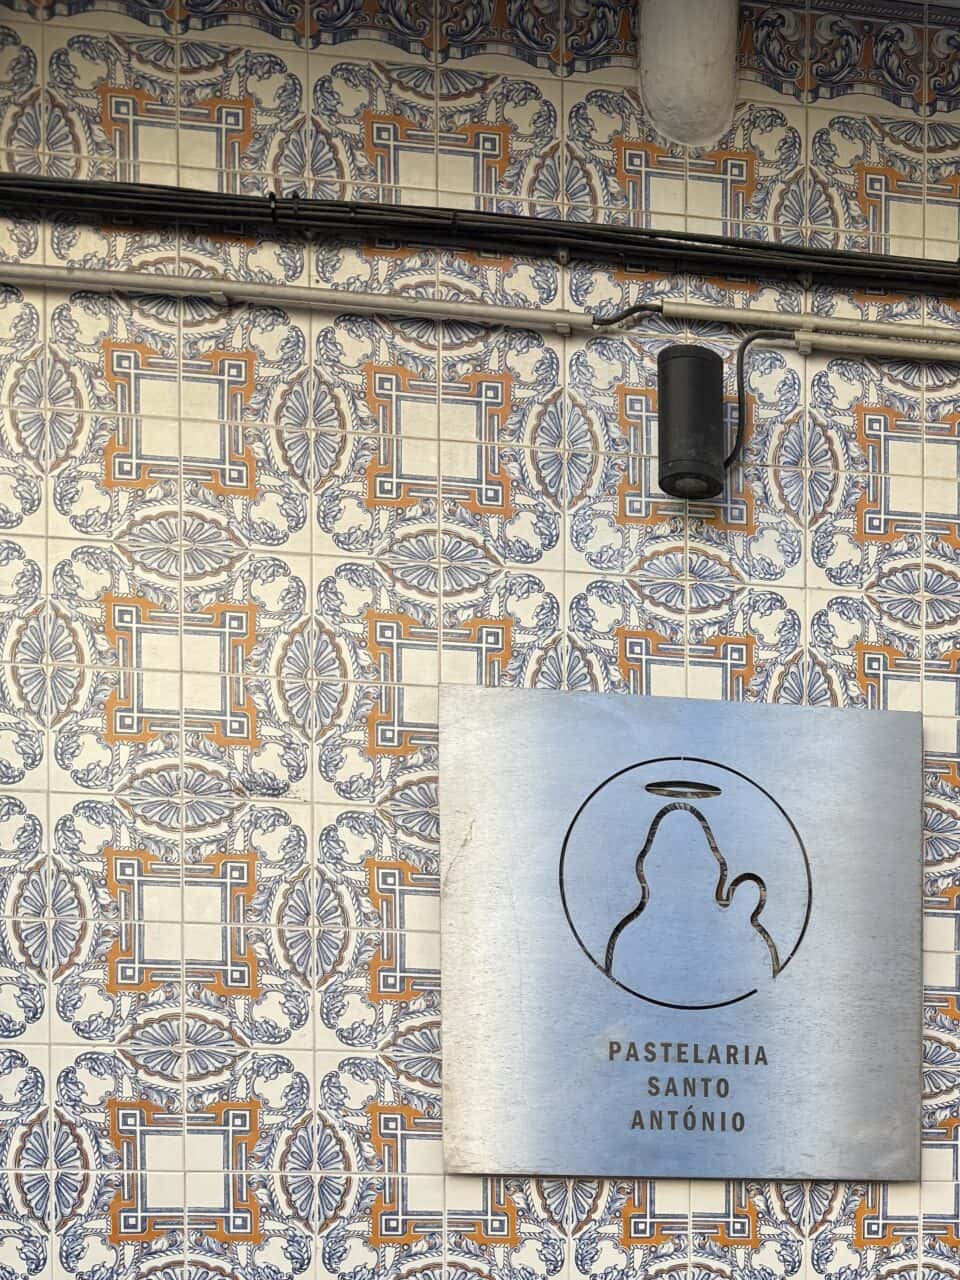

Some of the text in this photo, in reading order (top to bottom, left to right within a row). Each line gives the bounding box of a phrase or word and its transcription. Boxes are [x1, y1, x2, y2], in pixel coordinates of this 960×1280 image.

[608, 1040, 768, 1065] PASTELARIA
[647, 1076, 730, 1098] SANTO
[631, 1104, 745, 1132] ANTÓNIO
